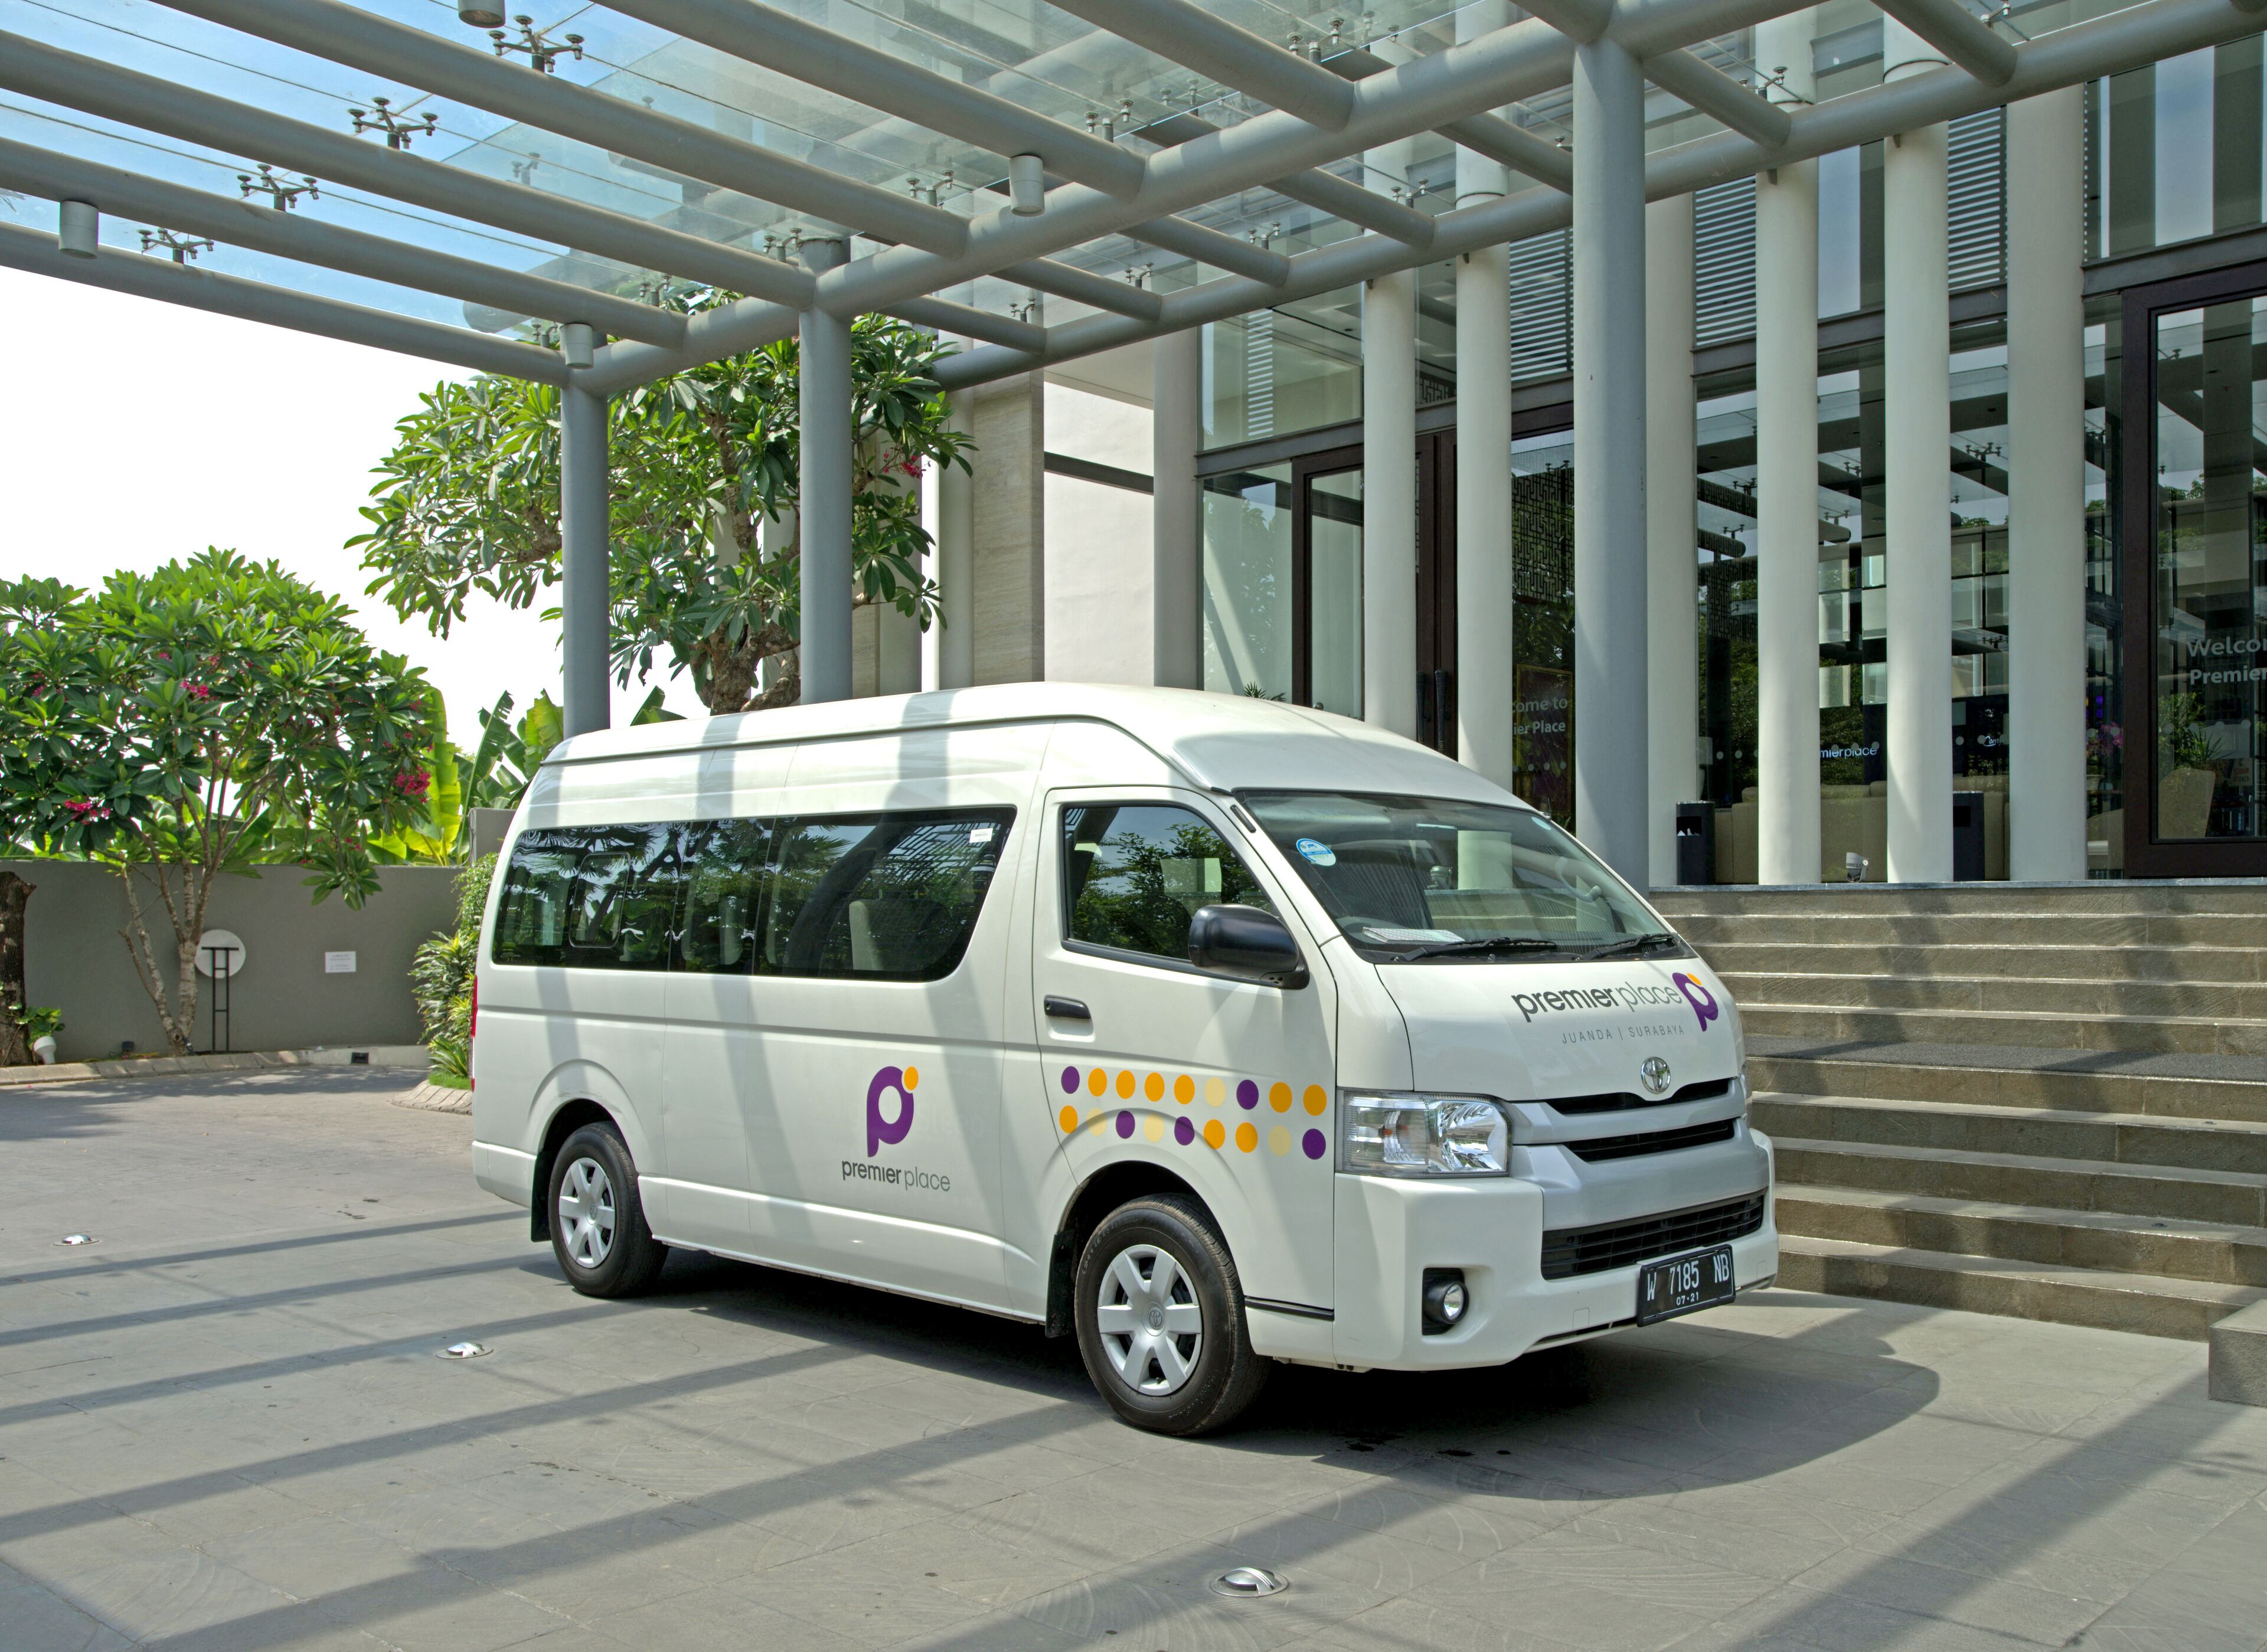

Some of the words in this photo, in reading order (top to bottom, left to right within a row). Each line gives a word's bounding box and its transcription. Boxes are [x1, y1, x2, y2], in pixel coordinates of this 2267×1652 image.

[1553, 697, 1568, 709] to
[1533, 719, 1566, 734] Place
[1562, 1029, 1613, 1044] JUANDA
[1629, 1025, 1685, 1038] SURABAYA
[1647, 1272, 1657, 1301] W
[1670, 1260, 1699, 1295] 7185
[1713, 1253, 1730, 1283] NB
